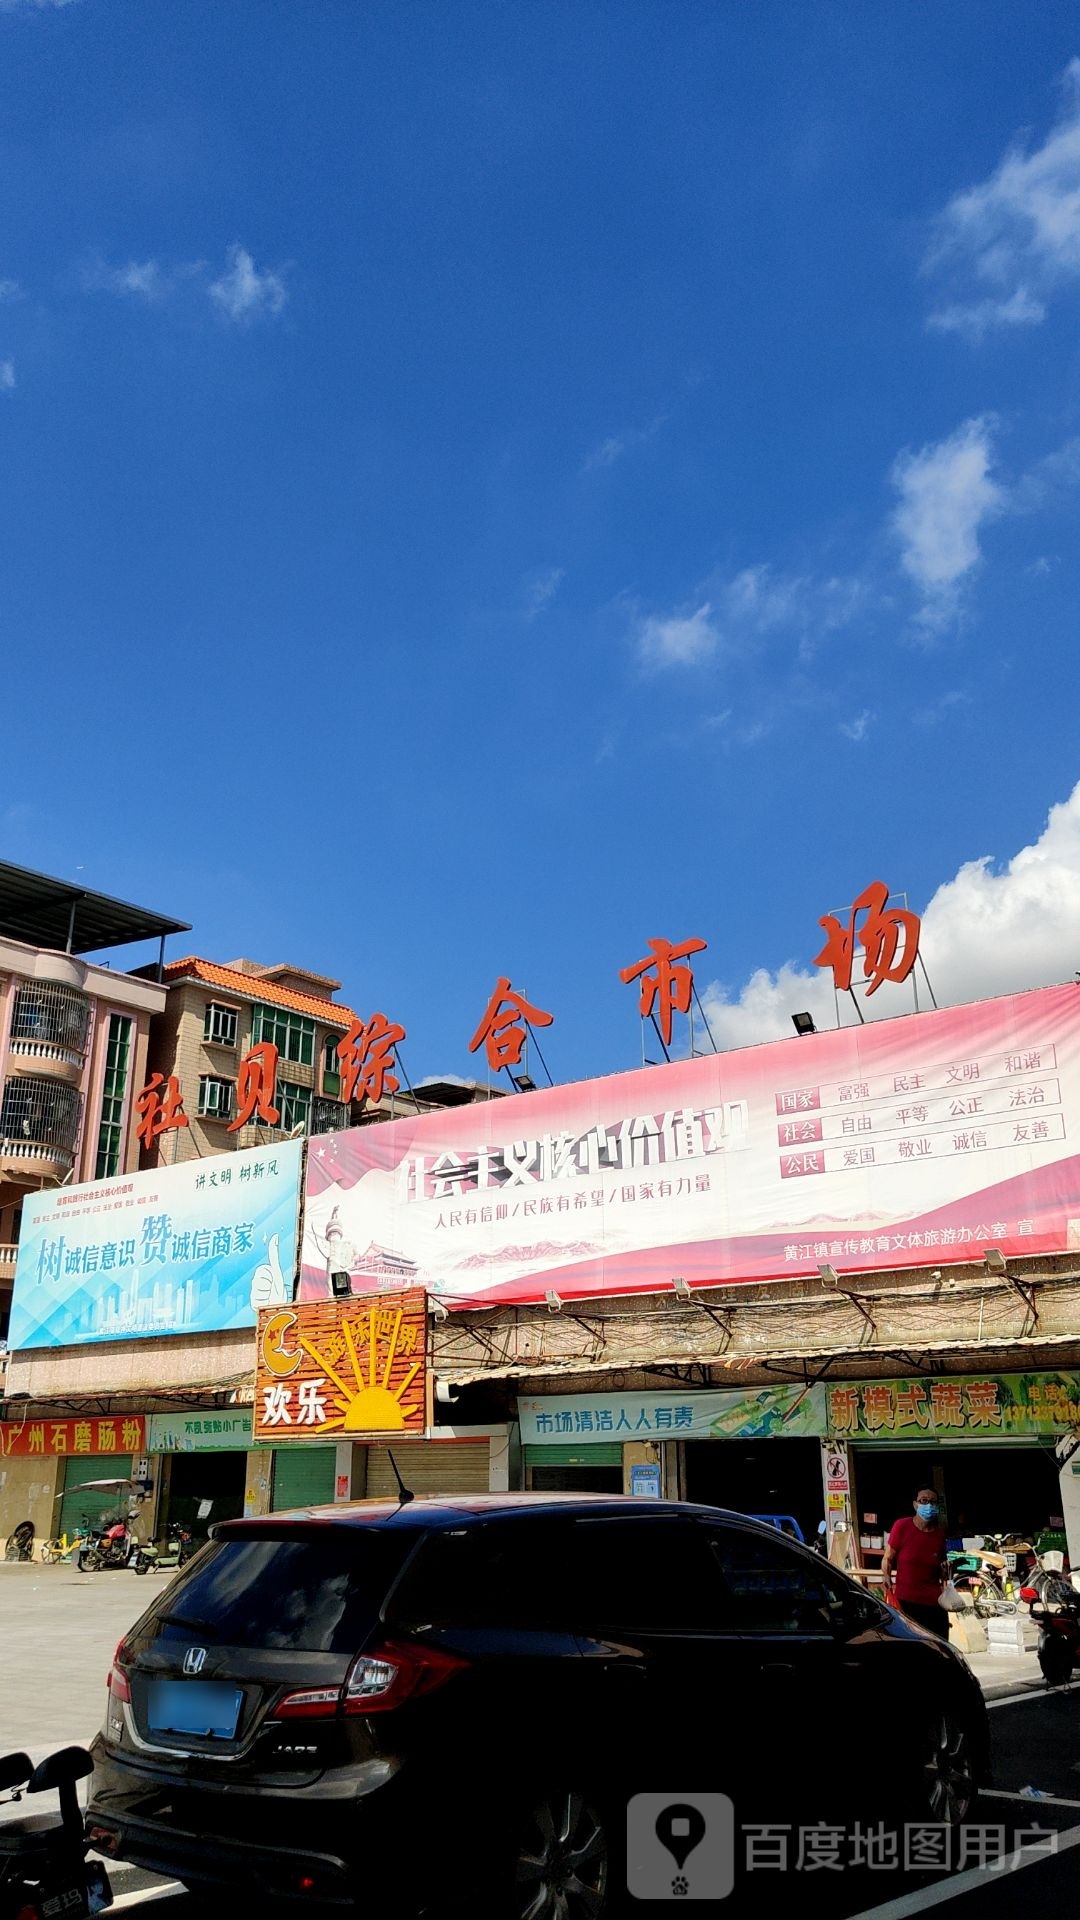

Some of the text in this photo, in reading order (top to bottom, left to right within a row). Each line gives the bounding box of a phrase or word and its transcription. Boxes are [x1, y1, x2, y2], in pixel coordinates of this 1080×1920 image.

[135, 881, 921, 1149] 社贝综合市场
[781, 1052, 1041, 1111] 国家 富强 民主 文明 和谐
[783, 1087, 1045, 1143] 社会 自由 平等 公正 法治
[399, 1100, 750, 1202] 社会主义核心价值观
[786, 1121, 1049, 1174] 公民 爱国 敬业 诚信 友善
[195, 1160, 279, 1190] 讲文明 树新风
[784, 1219, 1035, 1262] 黄江镇宣传教育文体旅游办公室 宣
[262, 1378, 327, 1425] 欢乐
[830, 1381, 1003, 1432] 新模式蔬菜
[1028, 1384, 1058, 1401] 电话
[6, 1418, 142, 1455] 广州石磨肠粉
[184, 1418, 252, 1434] 不乱张贴小广告
[535, 1406, 694, 1434] 市场清洁人人有责
